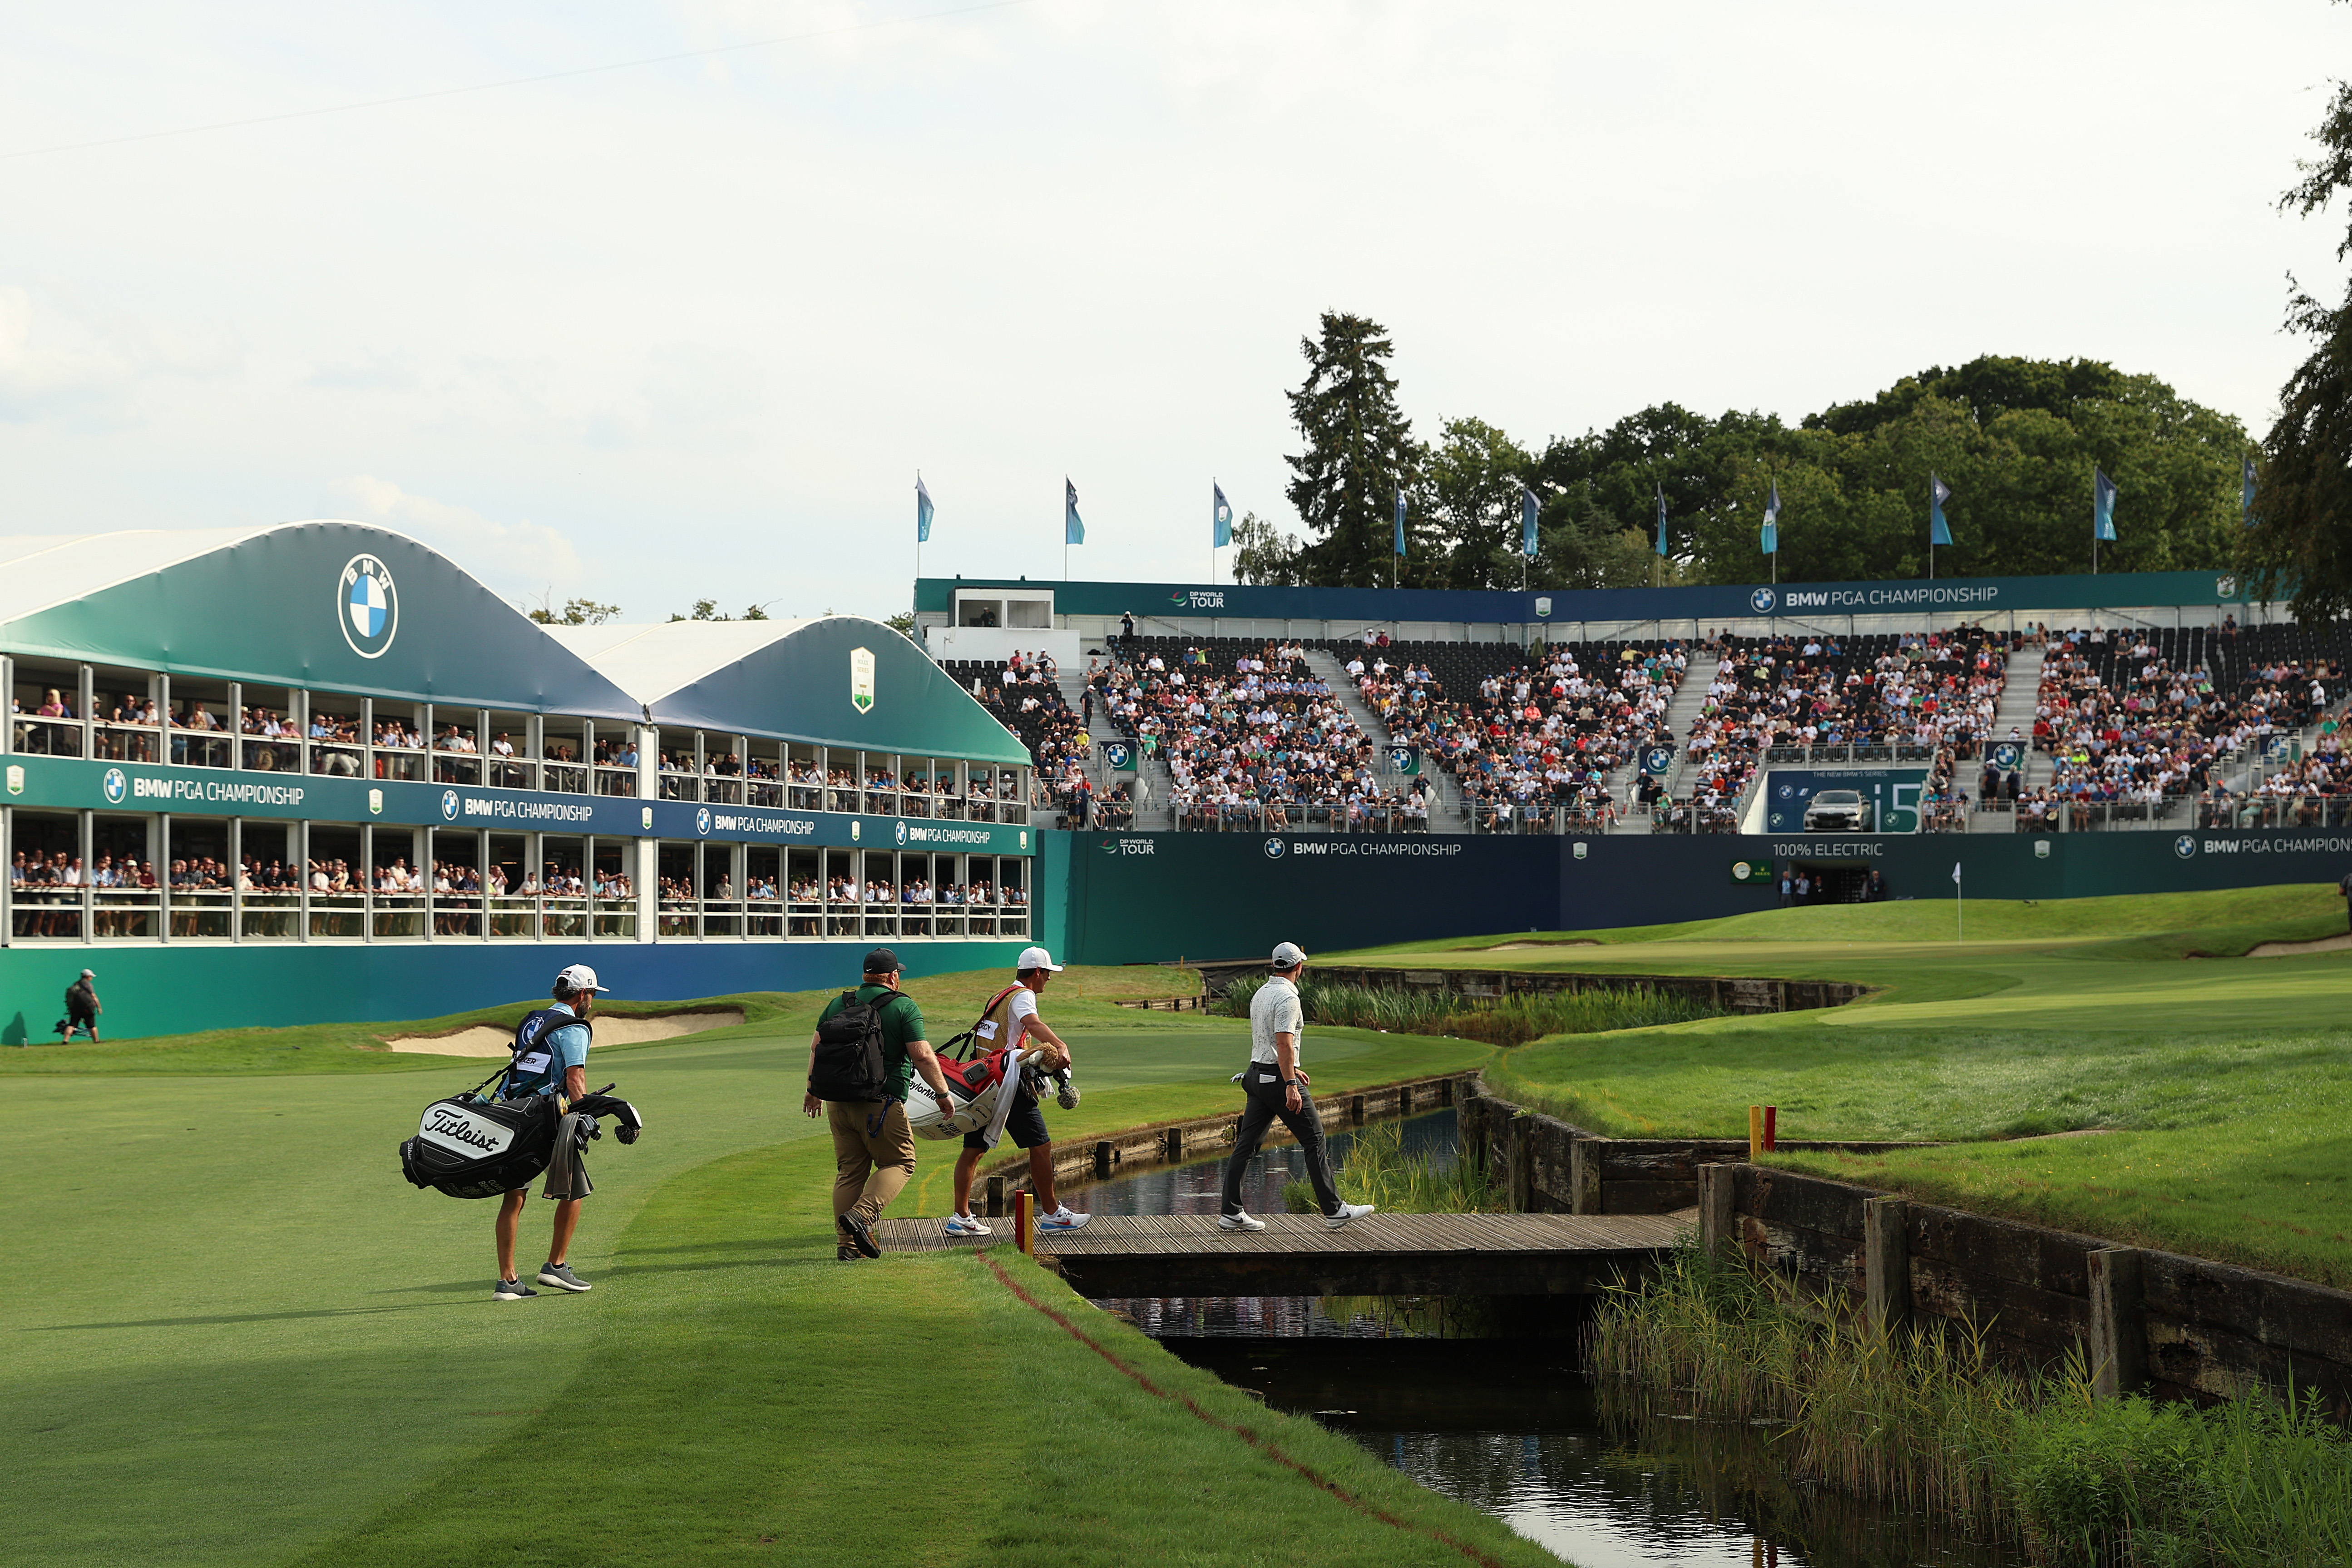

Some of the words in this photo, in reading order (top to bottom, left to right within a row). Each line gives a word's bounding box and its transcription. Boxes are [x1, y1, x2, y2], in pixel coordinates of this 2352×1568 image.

[346, 559, 390, 590] BMW
[1190, 597, 1224, 608] TOUR
[1786, 592, 1828, 607] BMW
[1832, 590, 1865, 606] PGA
[1869, 586, 1998, 605] CHAMPIONSHIP
[134, 778, 173, 798] BMW
[175, 780, 204, 800] PGA
[207, 782, 304, 805] CHAMPIONSHIP
[465, 798, 493, 816] BMW
[494, 800, 516, 817] PGA
[518, 801, 592, 821] CHAMPIONSHIP
[1874, 783, 1921, 835] i5
[715, 815, 736, 830] BMW
[738, 817, 755, 831] PGA
[756, 818, 814, 835] CHAMPIONSHIP
[910, 827, 927, 841] BMW
[928, 829, 942, 841] PGA
[943, 829, 990, 844] CHAMPIONSHIP
[1120, 844, 1154, 856] TOUR
[1294, 843, 1327, 854] BMW
[1330, 843, 1357, 855] PGA
[1361, 843, 1461, 856] CHAMPIONSHIP
[1773, 843, 1811, 856] 100%
[1816, 843, 1883, 856] ELECTRIC
[2204, 840, 2239, 854] BMW
[2242, 839, 2270, 853] PGA
[909, 1081, 936, 1101] aylorMa
[425, 1109, 500, 1152] Titleist
[947, 1123, 962, 1133] RORY
[489, 1180, 505, 1191] OLIVER
